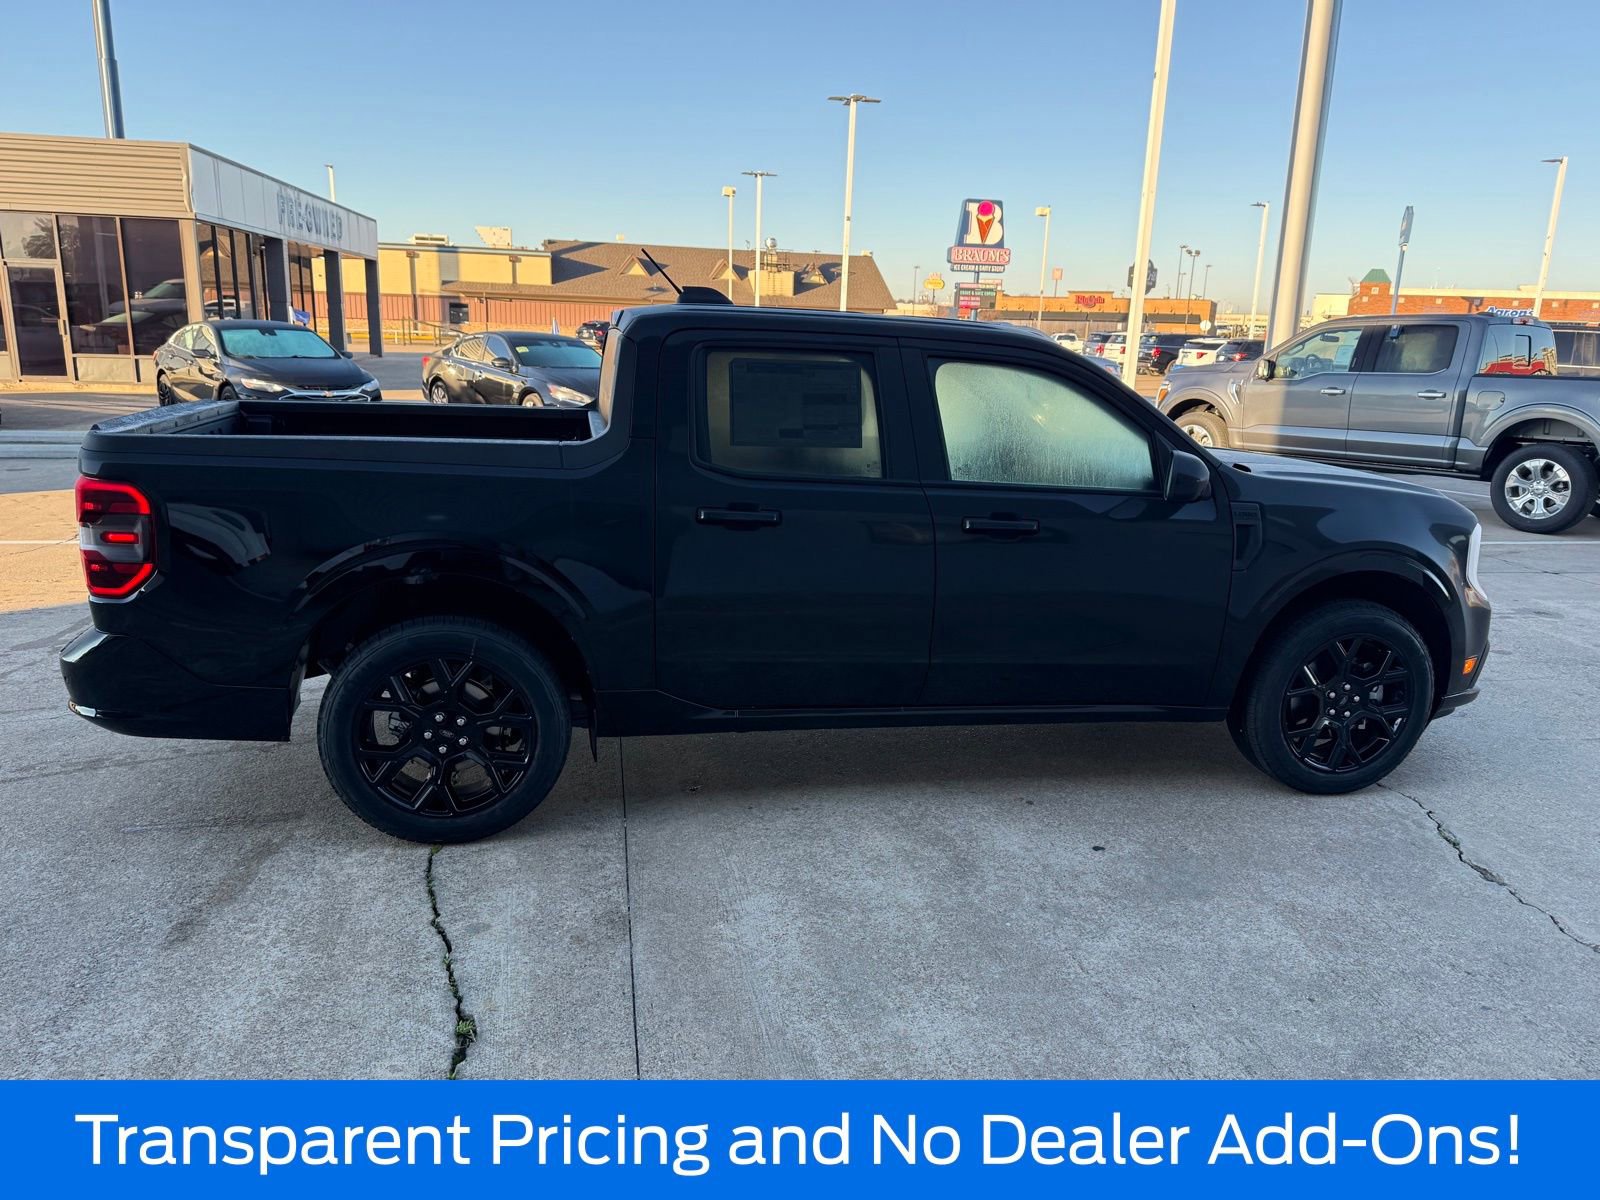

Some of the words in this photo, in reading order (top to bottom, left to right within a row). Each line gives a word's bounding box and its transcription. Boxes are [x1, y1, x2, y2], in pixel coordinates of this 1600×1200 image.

[276, 188, 343, 241] PRE-OWNED
[963, 201, 1004, 245] B
[954, 248, 1010, 263] BRAUM'S
[1487, 306, 1534, 318] Aaron's
